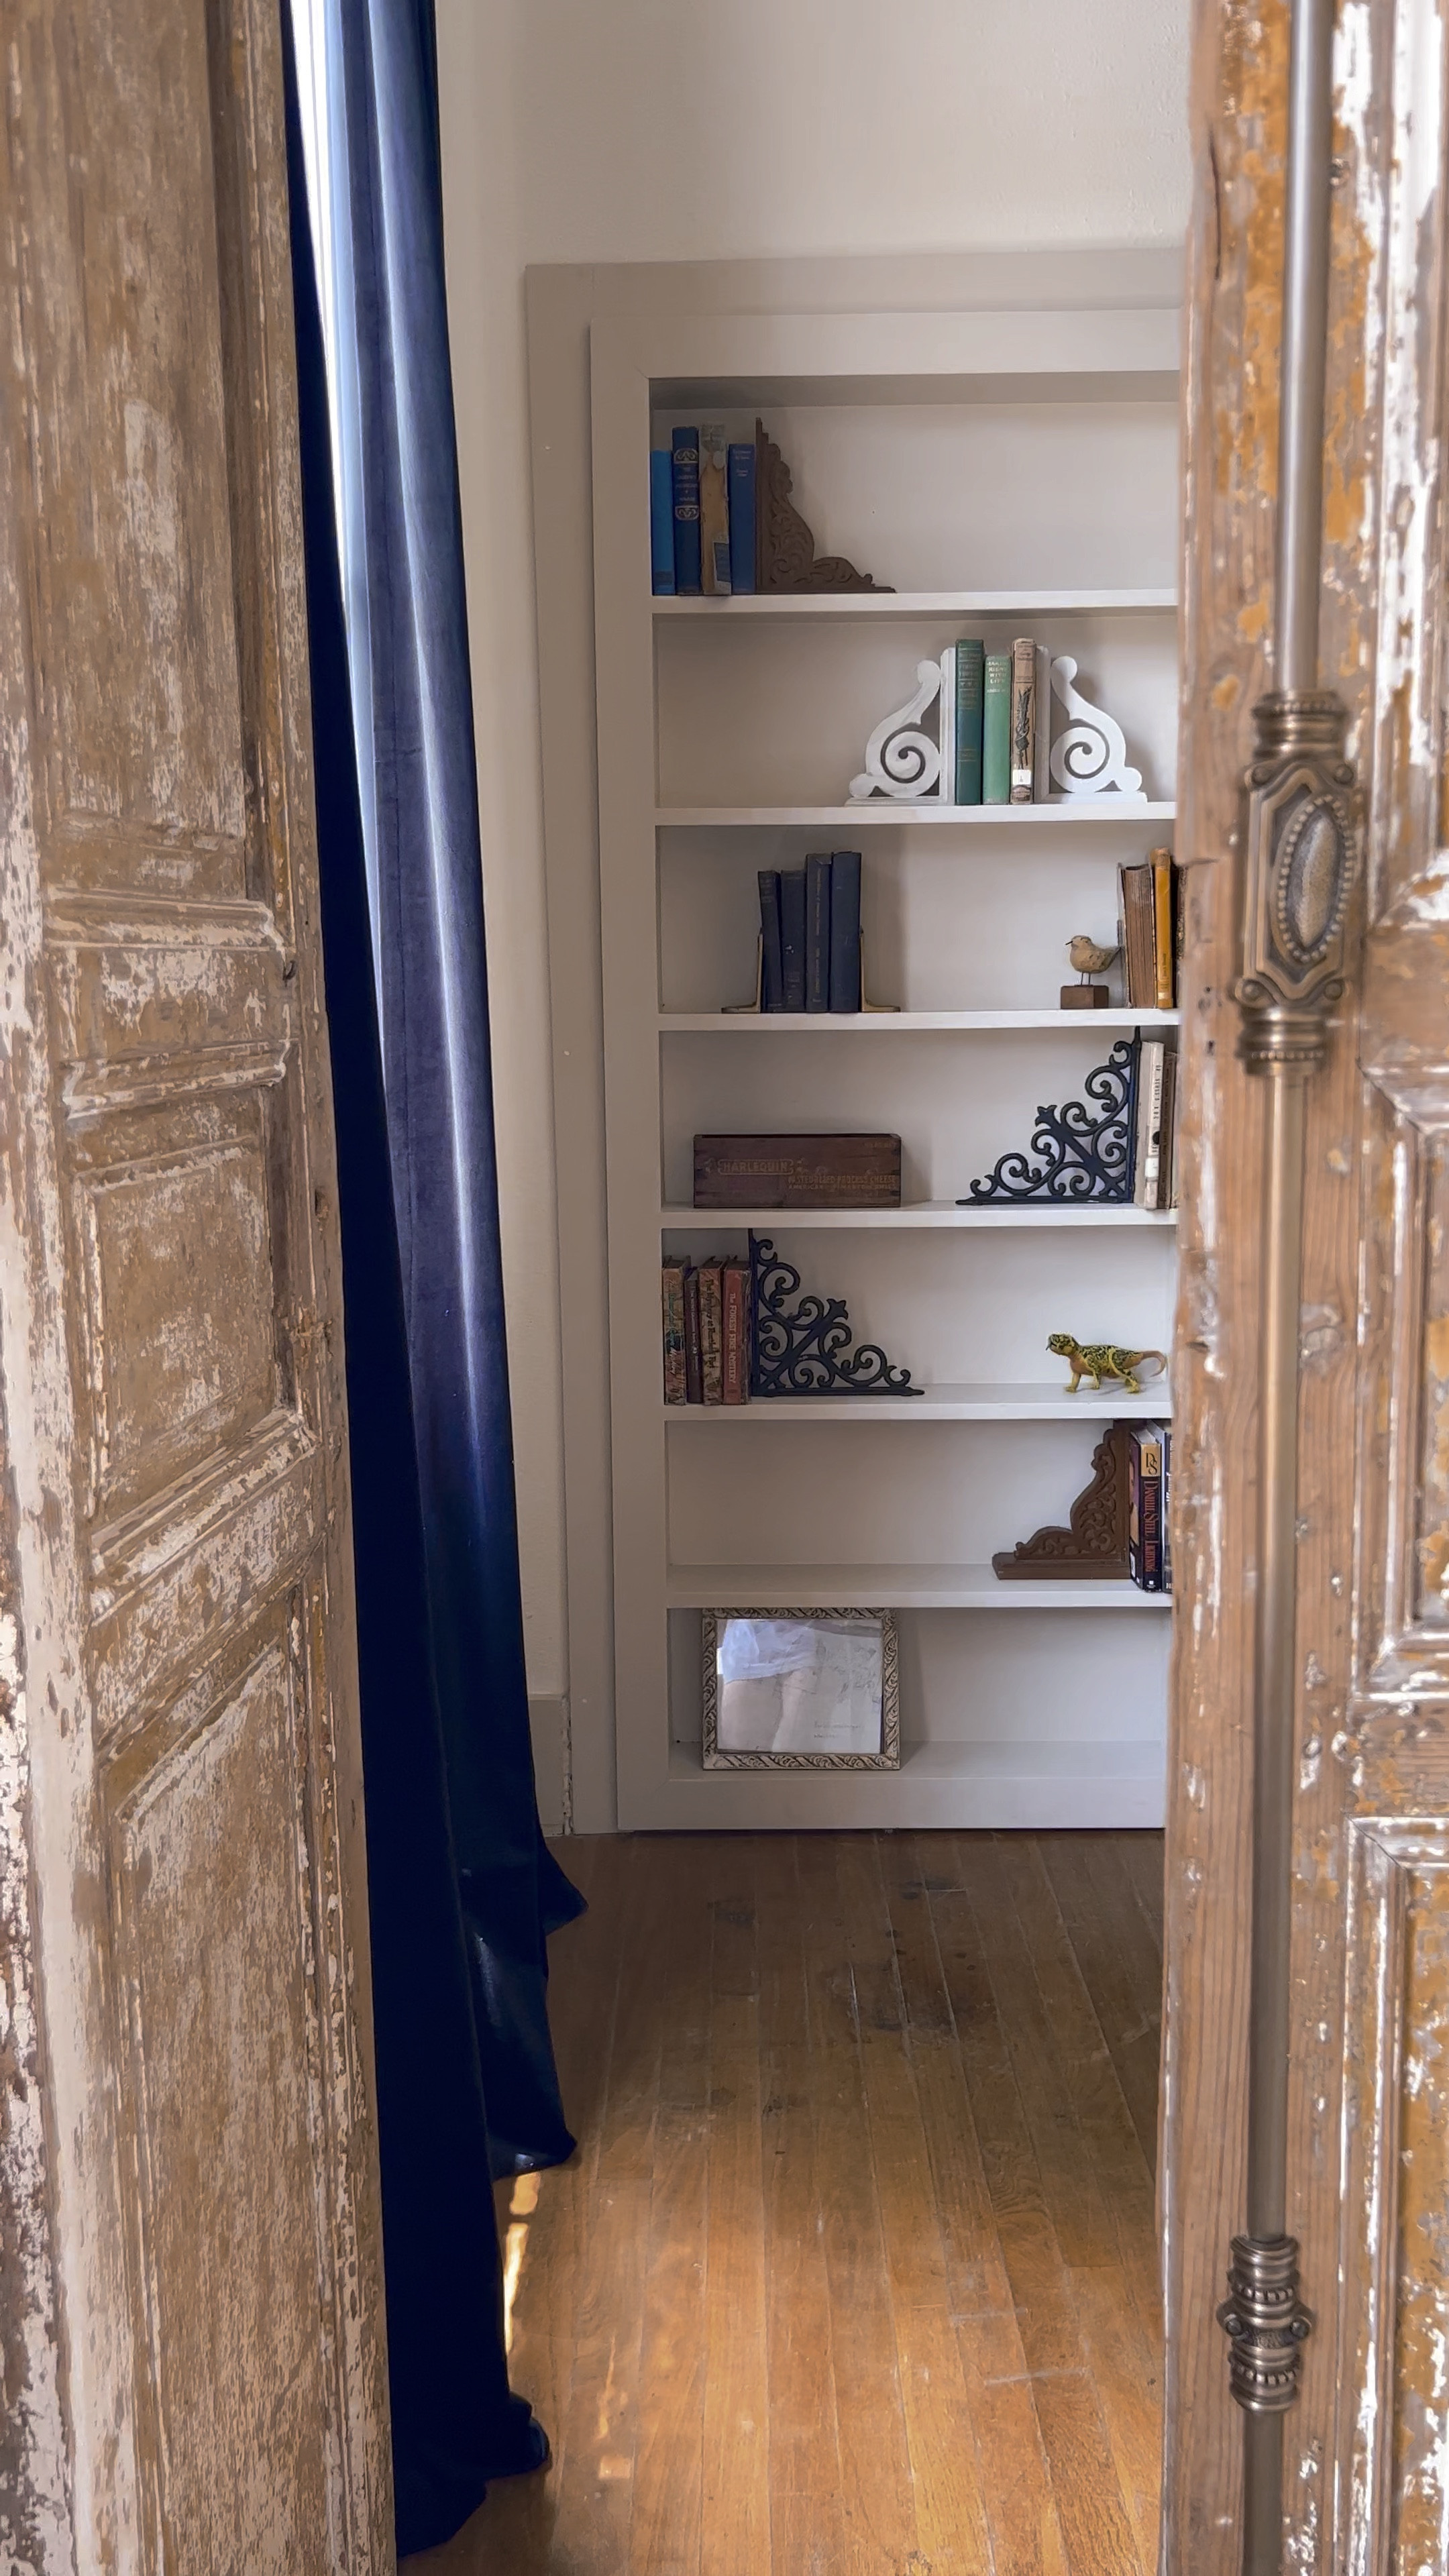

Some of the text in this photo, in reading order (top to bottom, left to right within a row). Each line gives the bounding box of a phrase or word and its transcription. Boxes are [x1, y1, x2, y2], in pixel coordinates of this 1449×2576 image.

[723, 1161, 789, 1173] HARLEQUIN
[729, 1305, 737, 1332] FOREST
[729, 1333, 737, 1350] FIRE
[729, 1352, 737, 1383] MYSTERY
[1144, 1481, 1158, 1511] DANIELLE
[1143, 1512, 1159, 1536] STEEL
